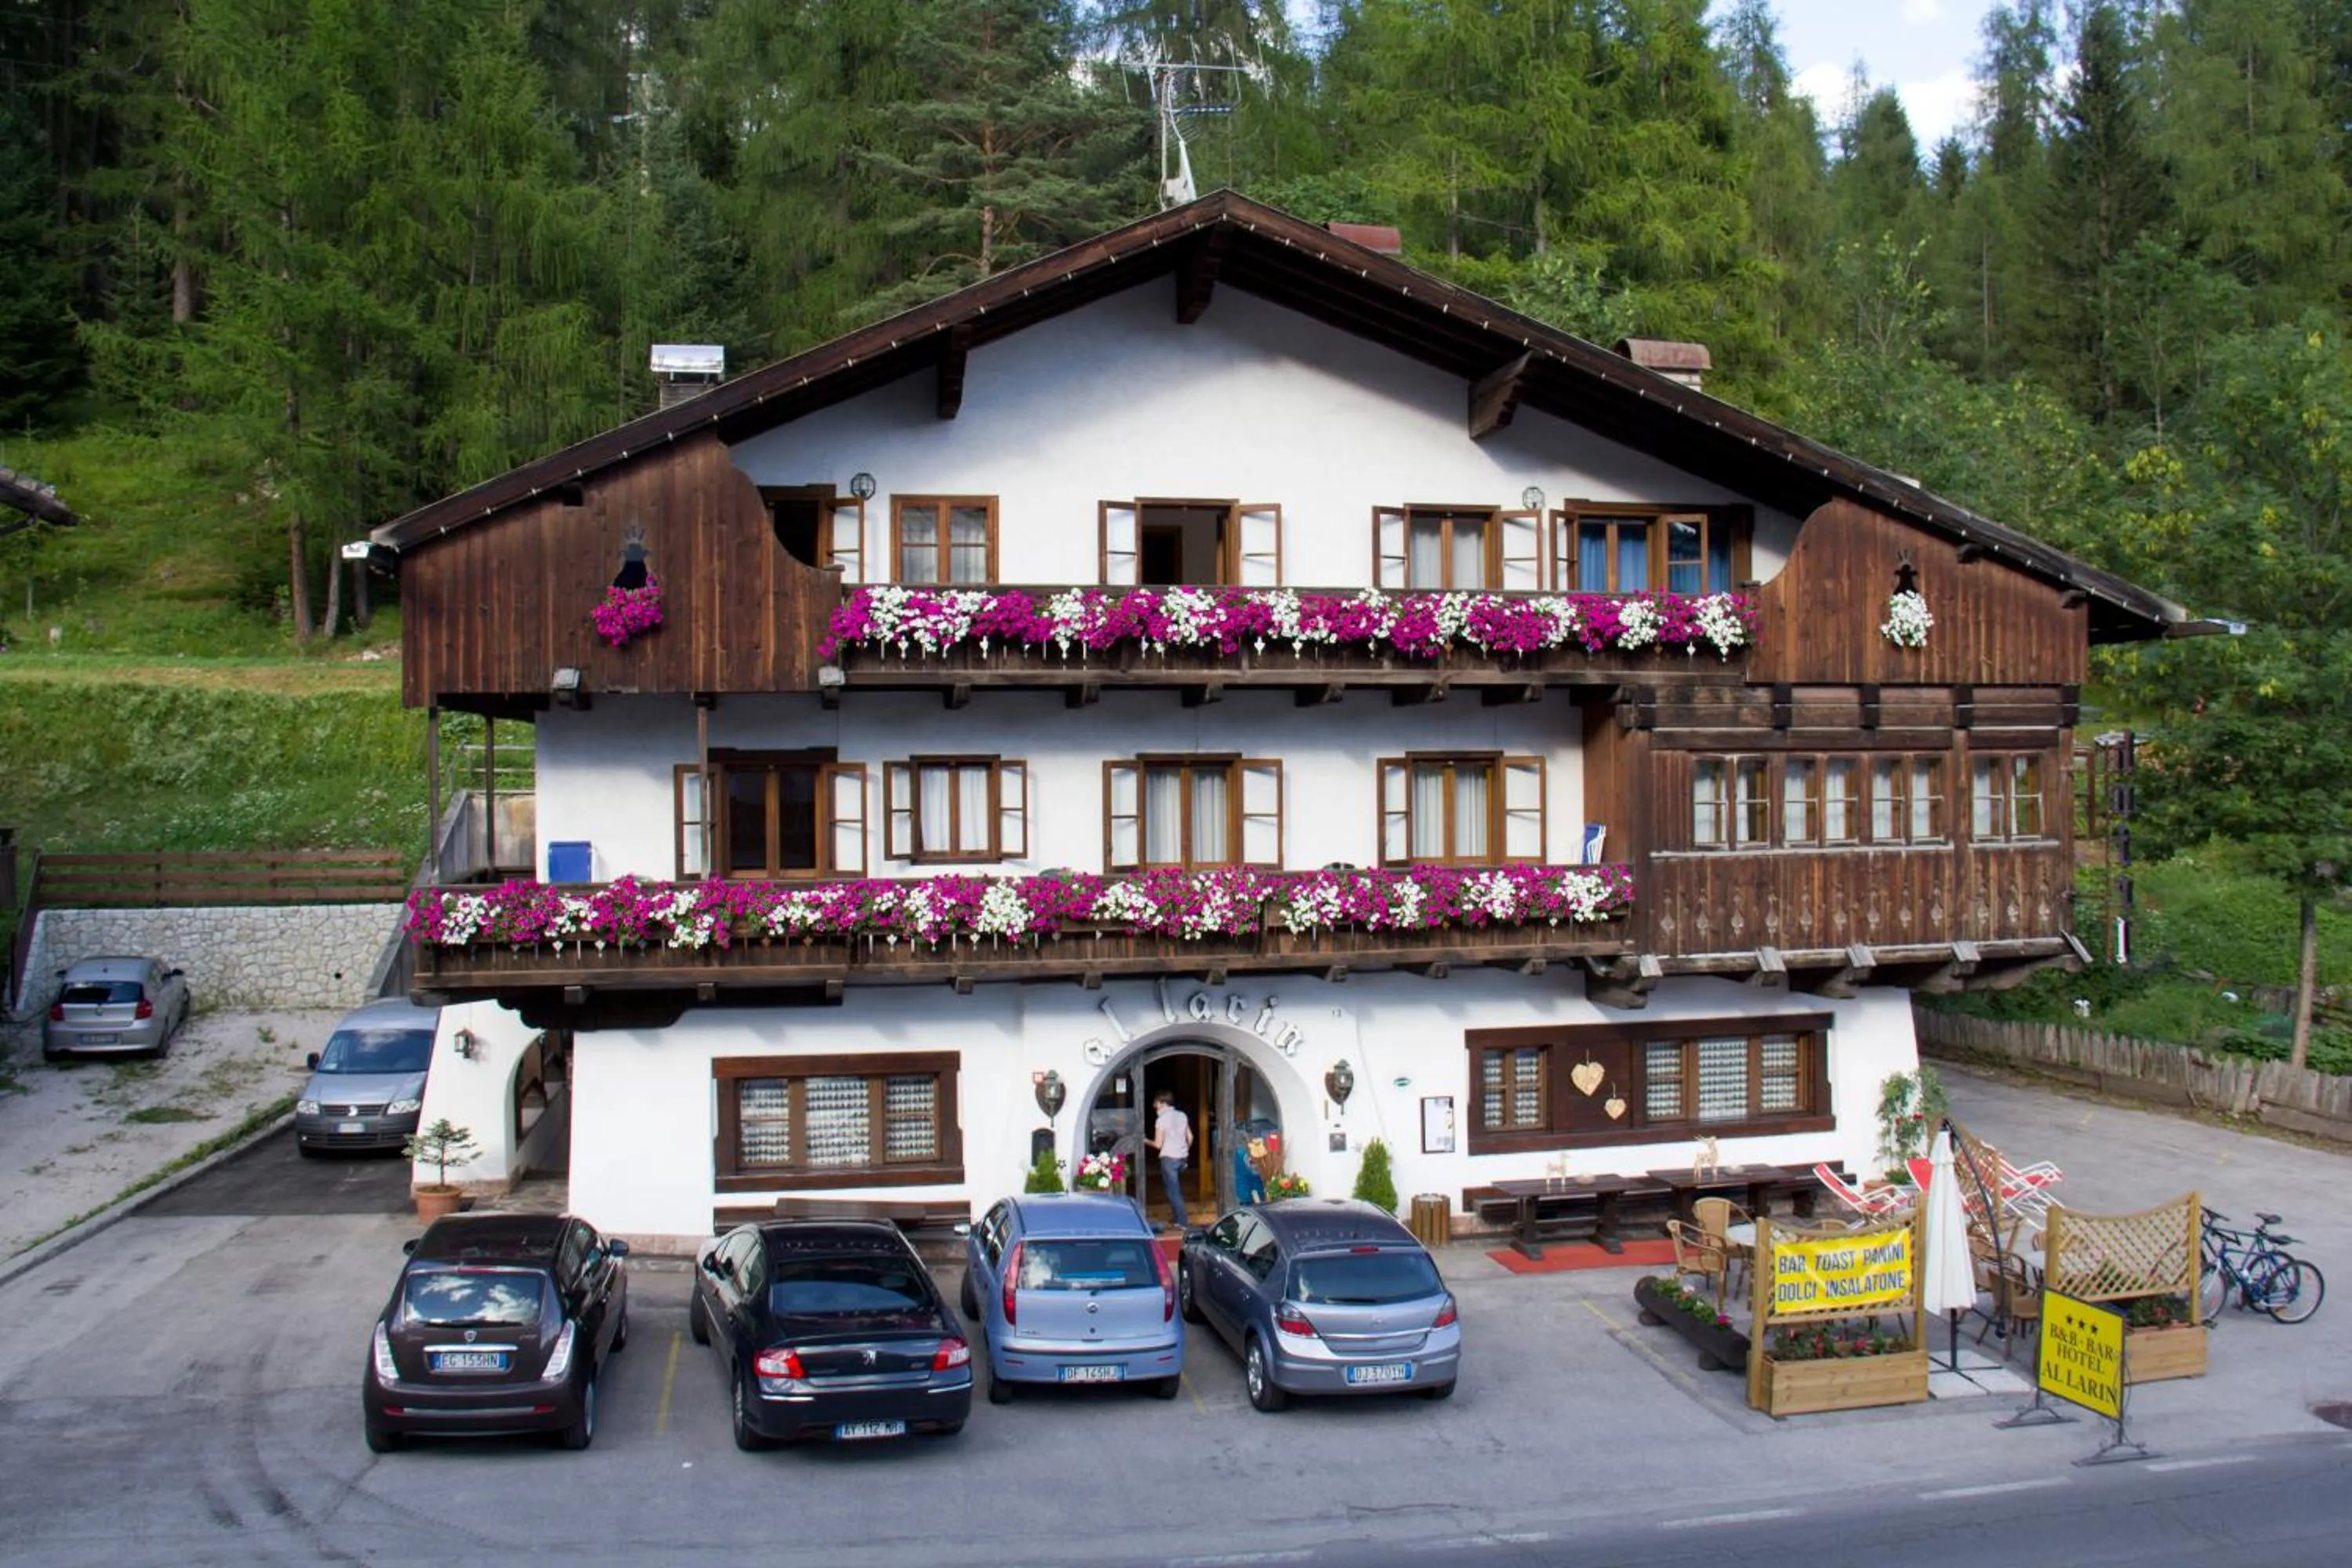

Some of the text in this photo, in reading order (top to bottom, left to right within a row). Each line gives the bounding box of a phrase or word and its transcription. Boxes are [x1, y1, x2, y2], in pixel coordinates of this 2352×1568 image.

[1778, 1241, 1905, 1274] BAR TOAST PANINI
[1777, 1269, 1907, 1302] DOLCI INSALATONE
[2056, 1341, 2106, 1374] HOTEL
[2086, 1337, 2114, 1362] BAR
[2042, 1360, 2119, 1406] AL LARIN
